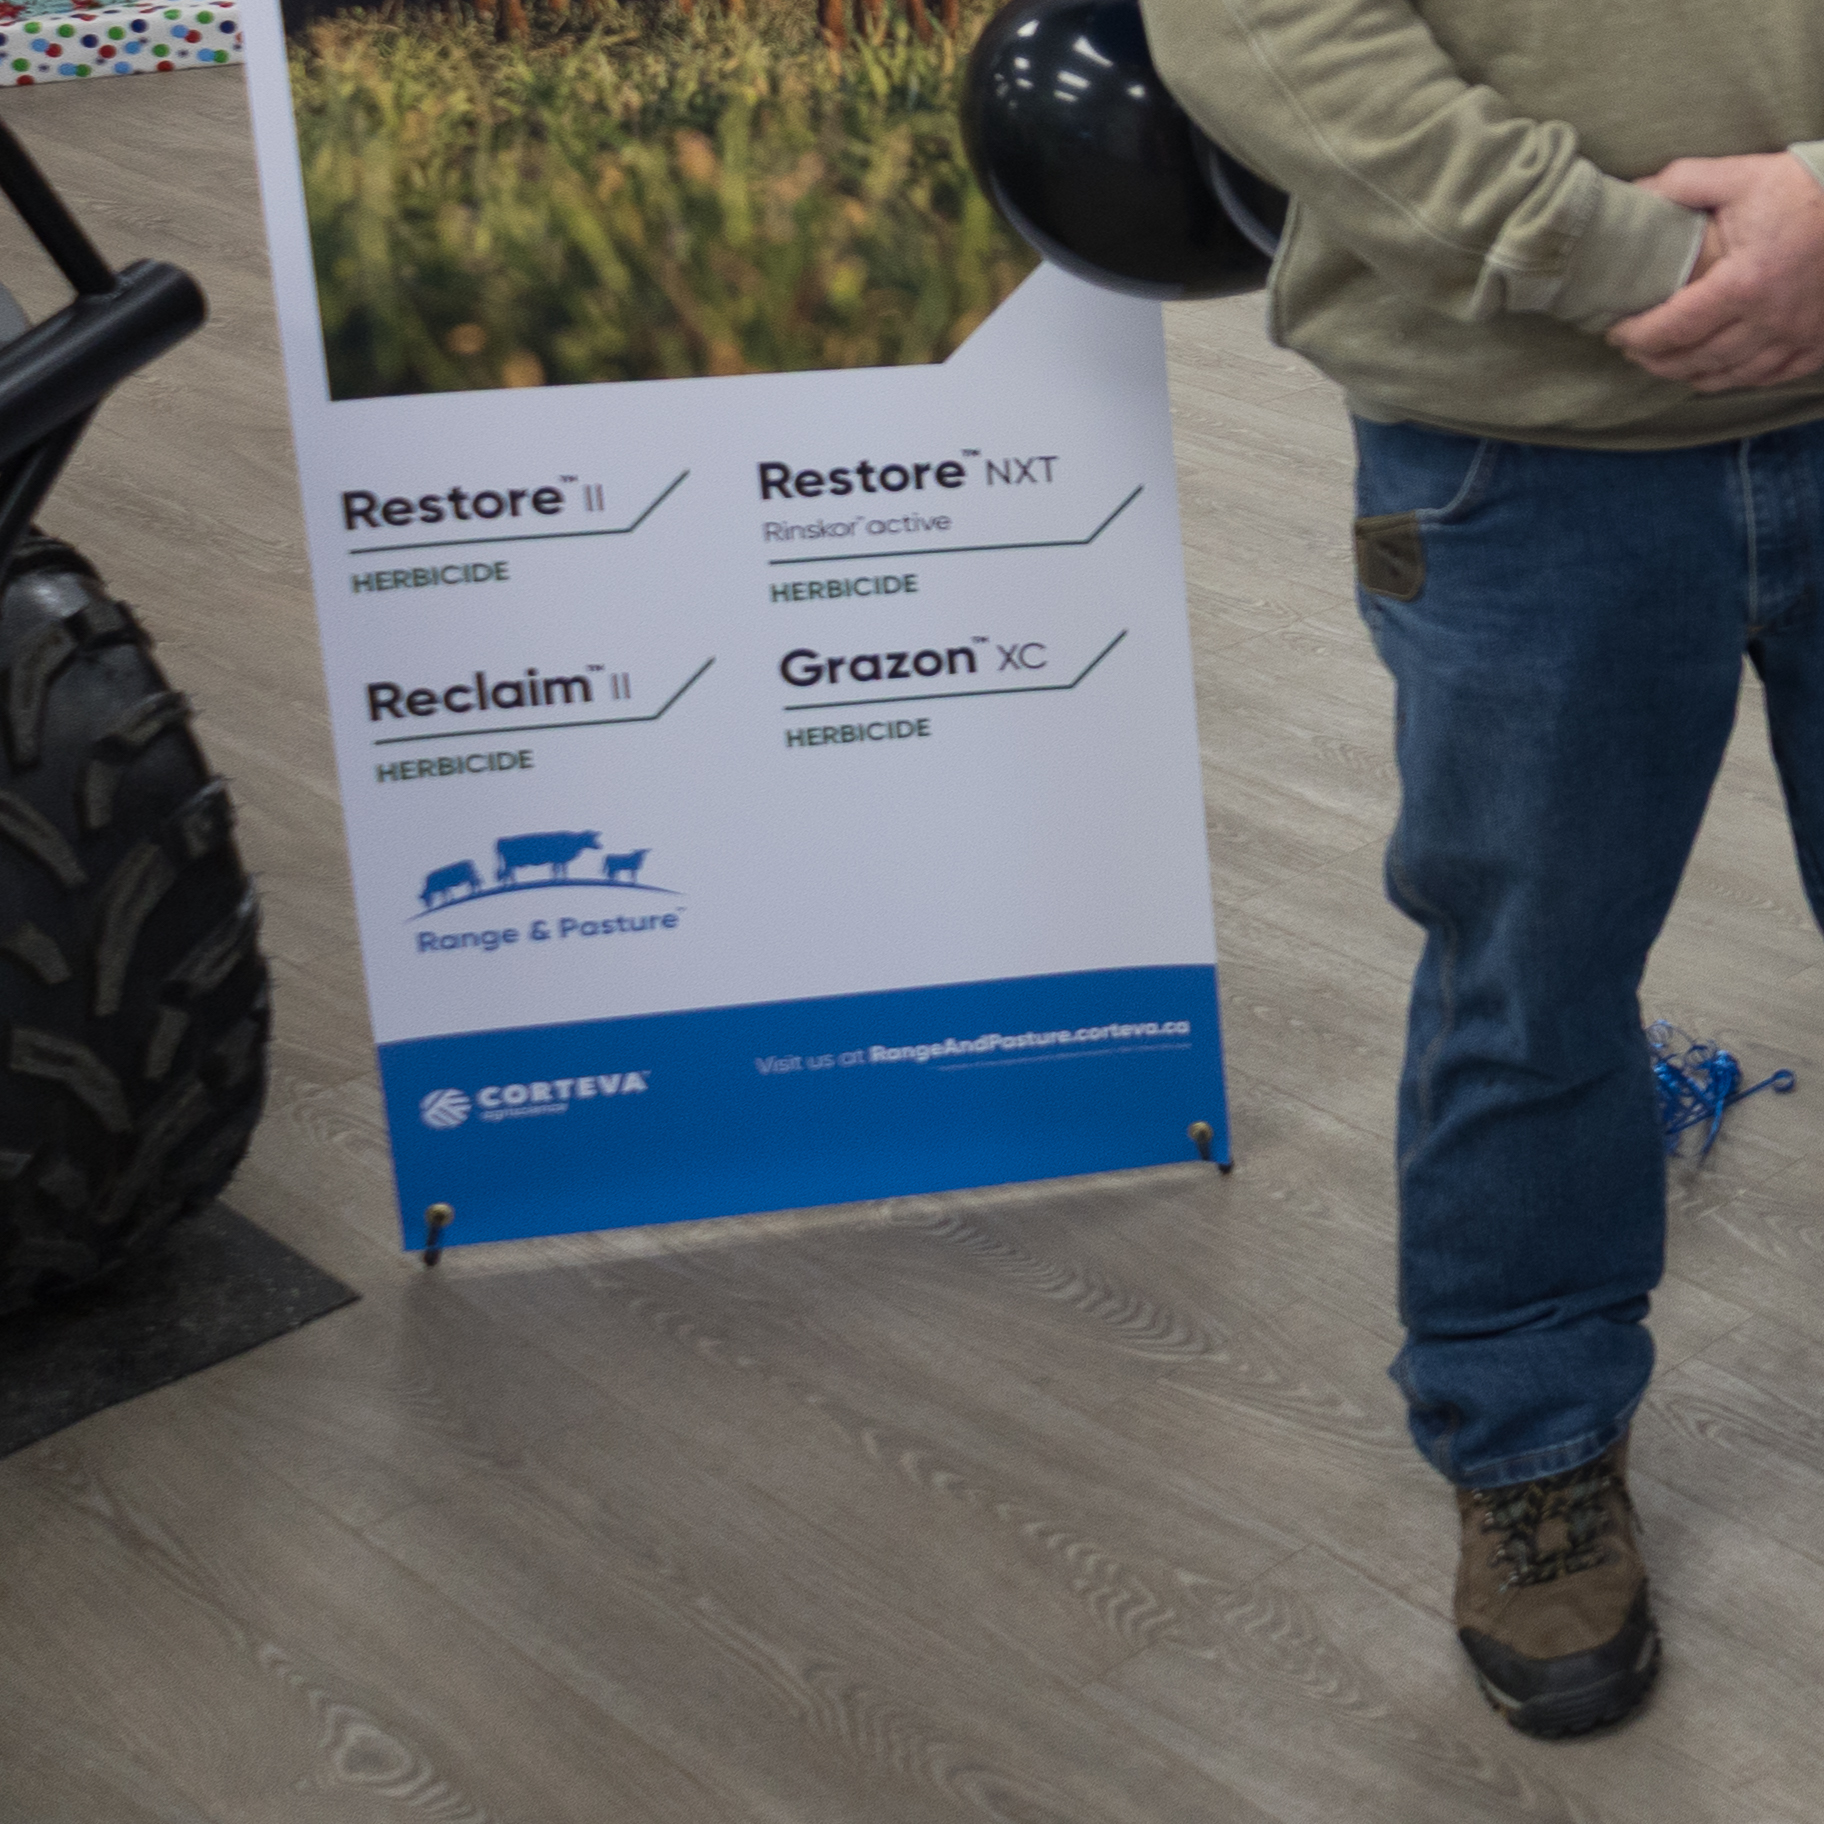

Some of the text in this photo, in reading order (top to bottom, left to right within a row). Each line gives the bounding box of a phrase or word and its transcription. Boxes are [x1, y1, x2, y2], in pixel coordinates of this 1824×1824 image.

[758, 455, 1060, 501] Restore NXT
[342, 485, 565, 531] Restore
[763, 512, 953, 544] Rinskor active
[352, 560, 511, 594] HERBICIDE
[770, 573, 919, 603] HERBICIDE
[780, 641, 1049, 688] Grazon XC
[366, 667, 593, 722] Reclaim
[785, 717, 932, 748] HERBICIDE
[376, 748, 535, 783] HERBICIDE
[416, 911, 681, 953] Range & Pasture
[754, 1053, 804, 1075] Visit
[806, 1052, 835, 1070] us
[838, 1049, 866, 1068] at
[475, 1071, 650, 1108] CORTEVA
